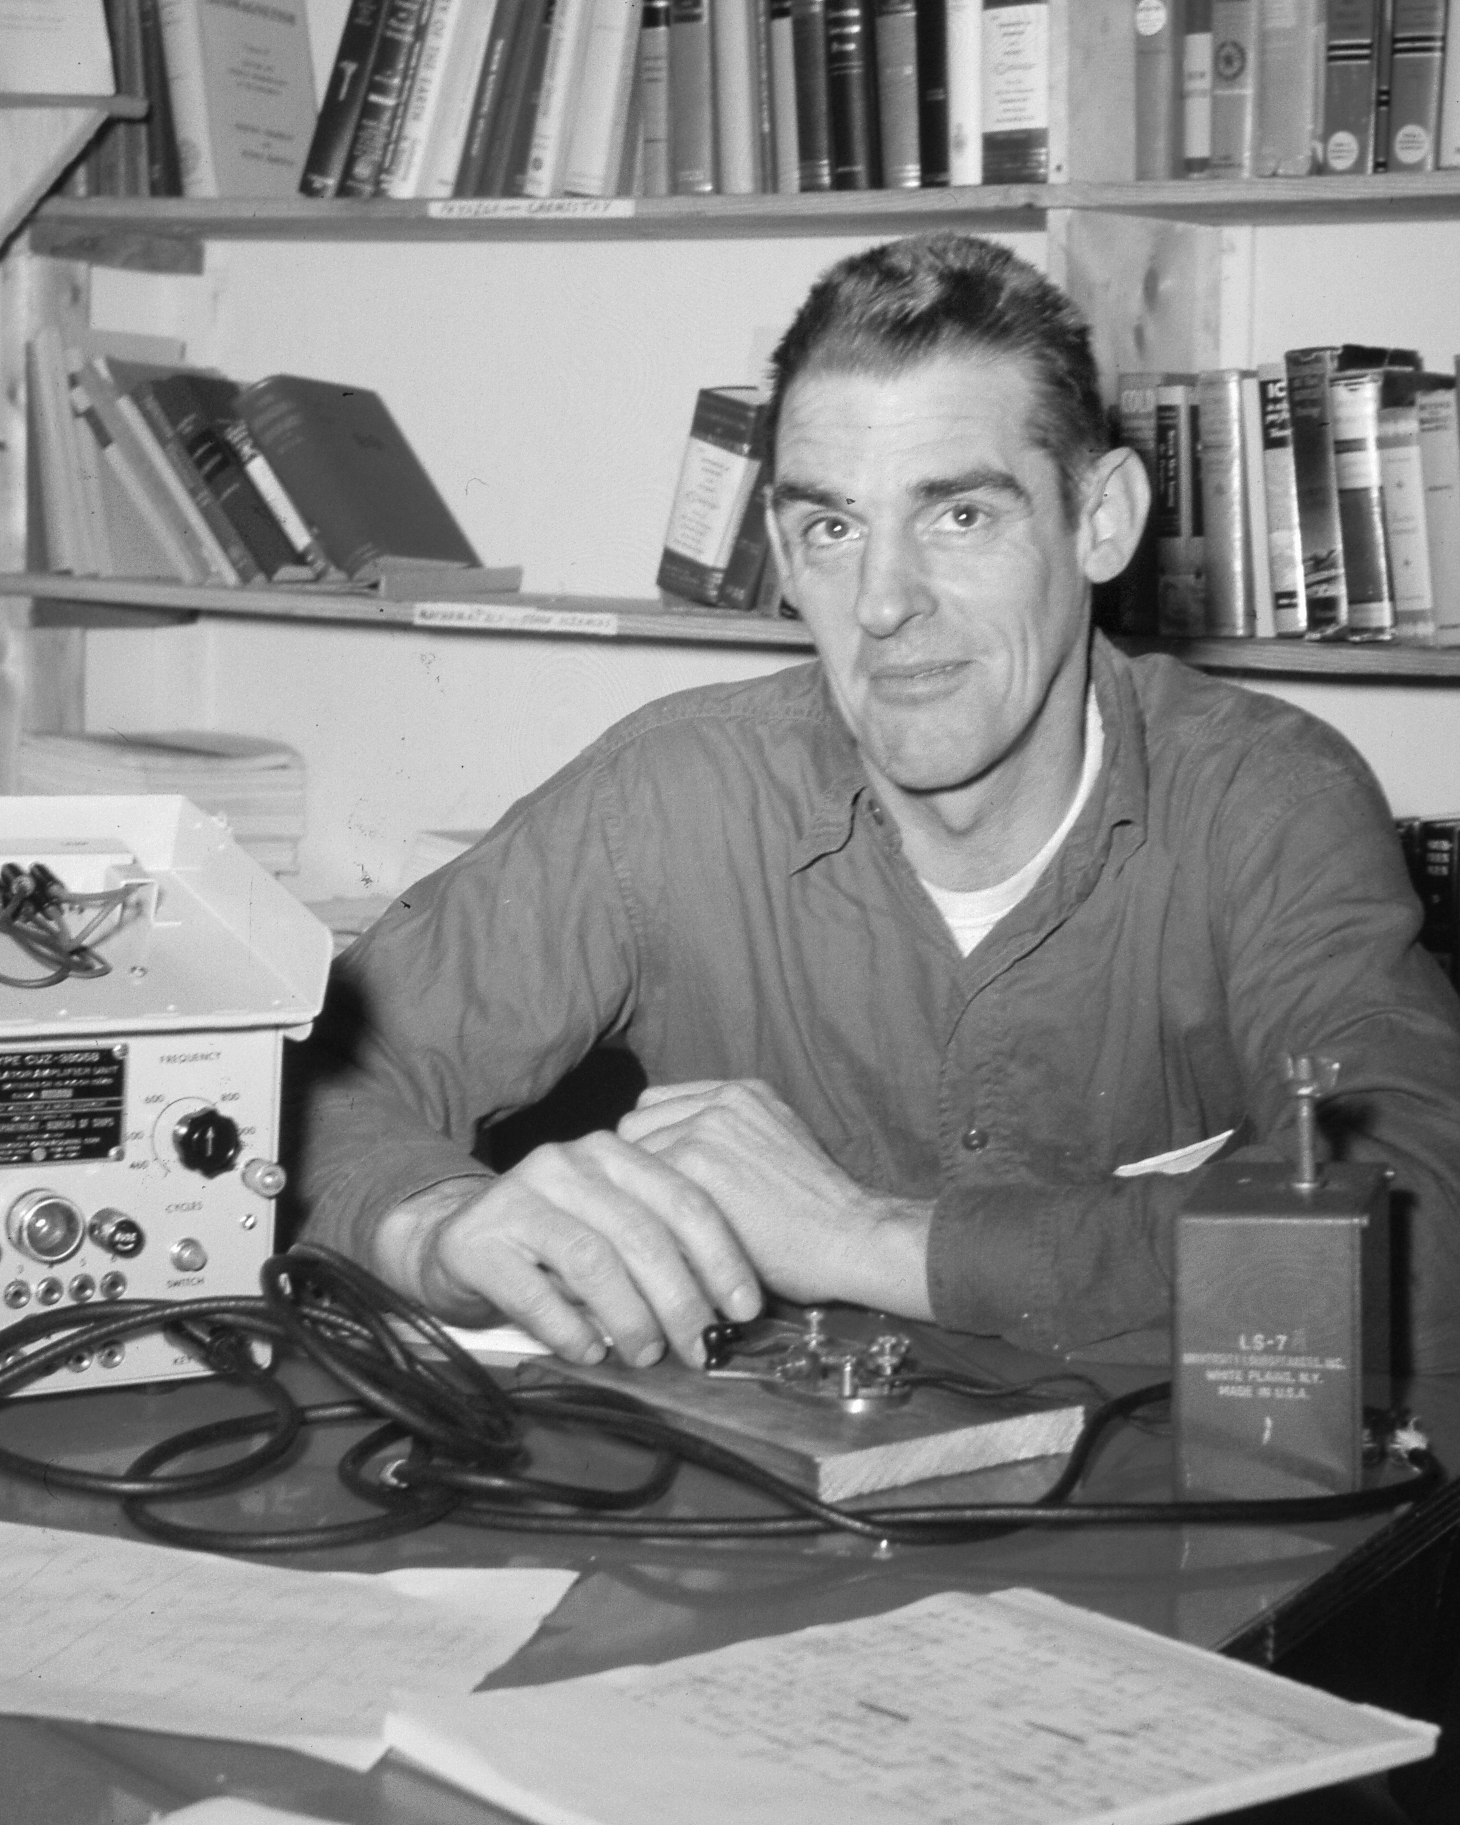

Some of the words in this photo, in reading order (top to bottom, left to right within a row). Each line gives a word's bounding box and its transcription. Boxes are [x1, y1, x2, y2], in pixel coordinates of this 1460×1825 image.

[159, 1051, 222, 1064] FREQUENCY
[145, 1094, 165, 1104] 600
[220, 1092, 241, 1102] 800
[165, 1200, 204, 1214] CYCLES
[166, 1276, 205, 1290] SWITCH
[1238, 1333, 1288, 1351] LS-7
[173, 1354, 194, 1366] KEY
